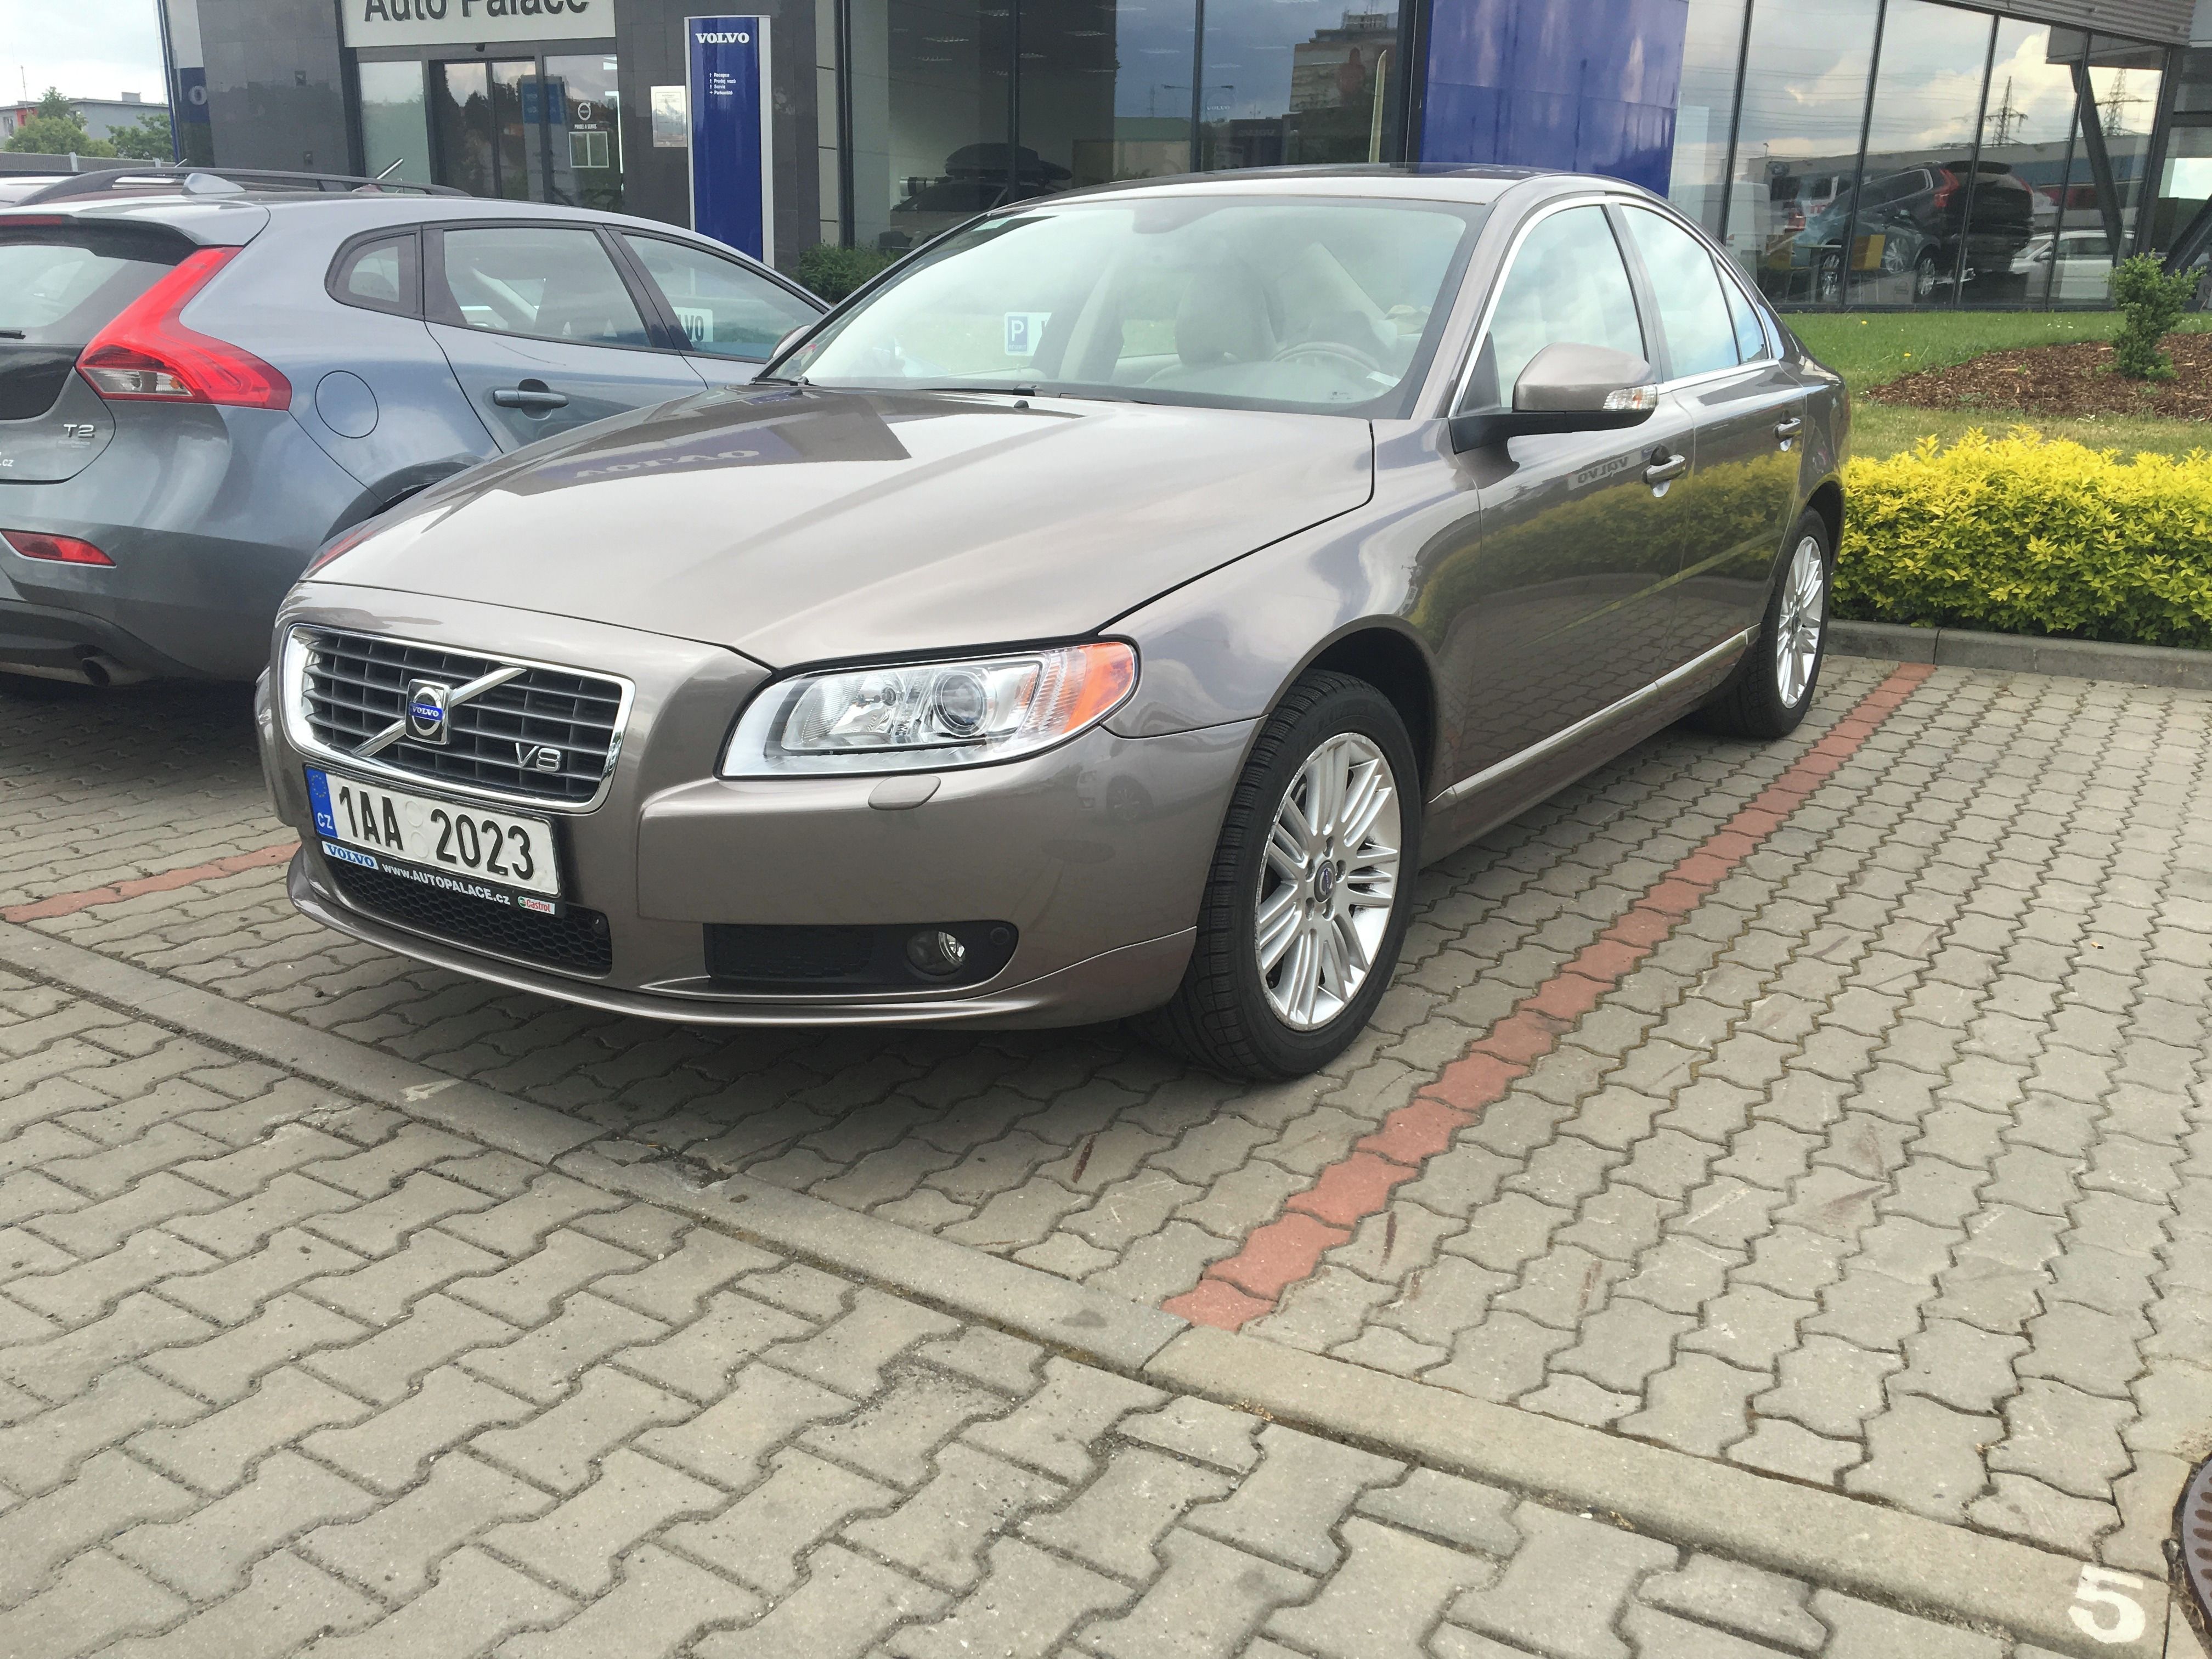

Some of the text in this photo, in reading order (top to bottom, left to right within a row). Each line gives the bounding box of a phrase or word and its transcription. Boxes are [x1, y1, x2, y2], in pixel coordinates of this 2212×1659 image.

[695, 32, 749, 43] VOLVO
[1011, 320, 1024, 341] P
[63, 424, 95, 438] T2
[412, 706, 439, 717] VOLVO
[515, 742, 562, 772] V8
[317, 811, 334, 830] CZ
[339, 786, 534, 880] 1AA 2023
[326, 844, 375, 868] VOLVO
[527, 899, 551, 912] Castrol
[2068, 1564, 2146, 1644] 5
